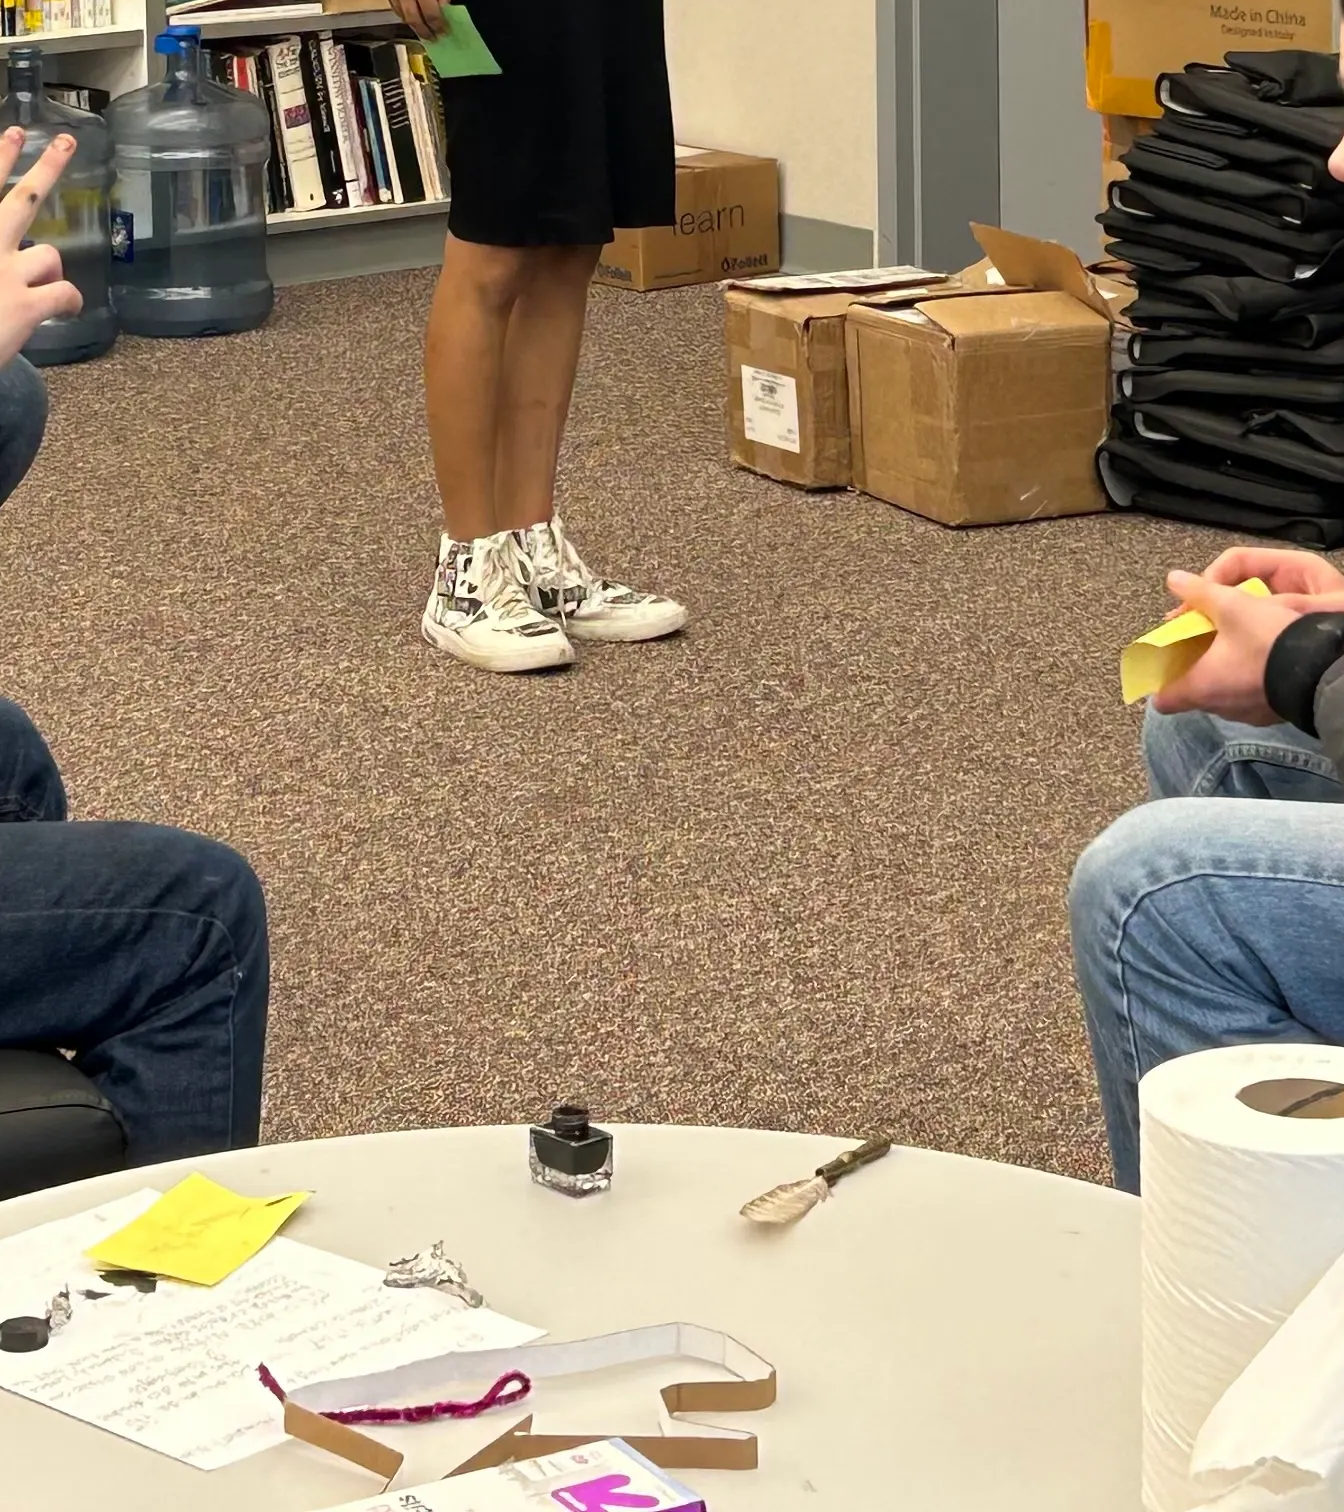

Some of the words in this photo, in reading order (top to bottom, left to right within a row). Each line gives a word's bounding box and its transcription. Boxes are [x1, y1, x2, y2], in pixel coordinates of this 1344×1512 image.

[1210, 4, 1247, 23] Made
[1250, 8, 1263, 24] in
[1265, 9, 1307, 27] China
